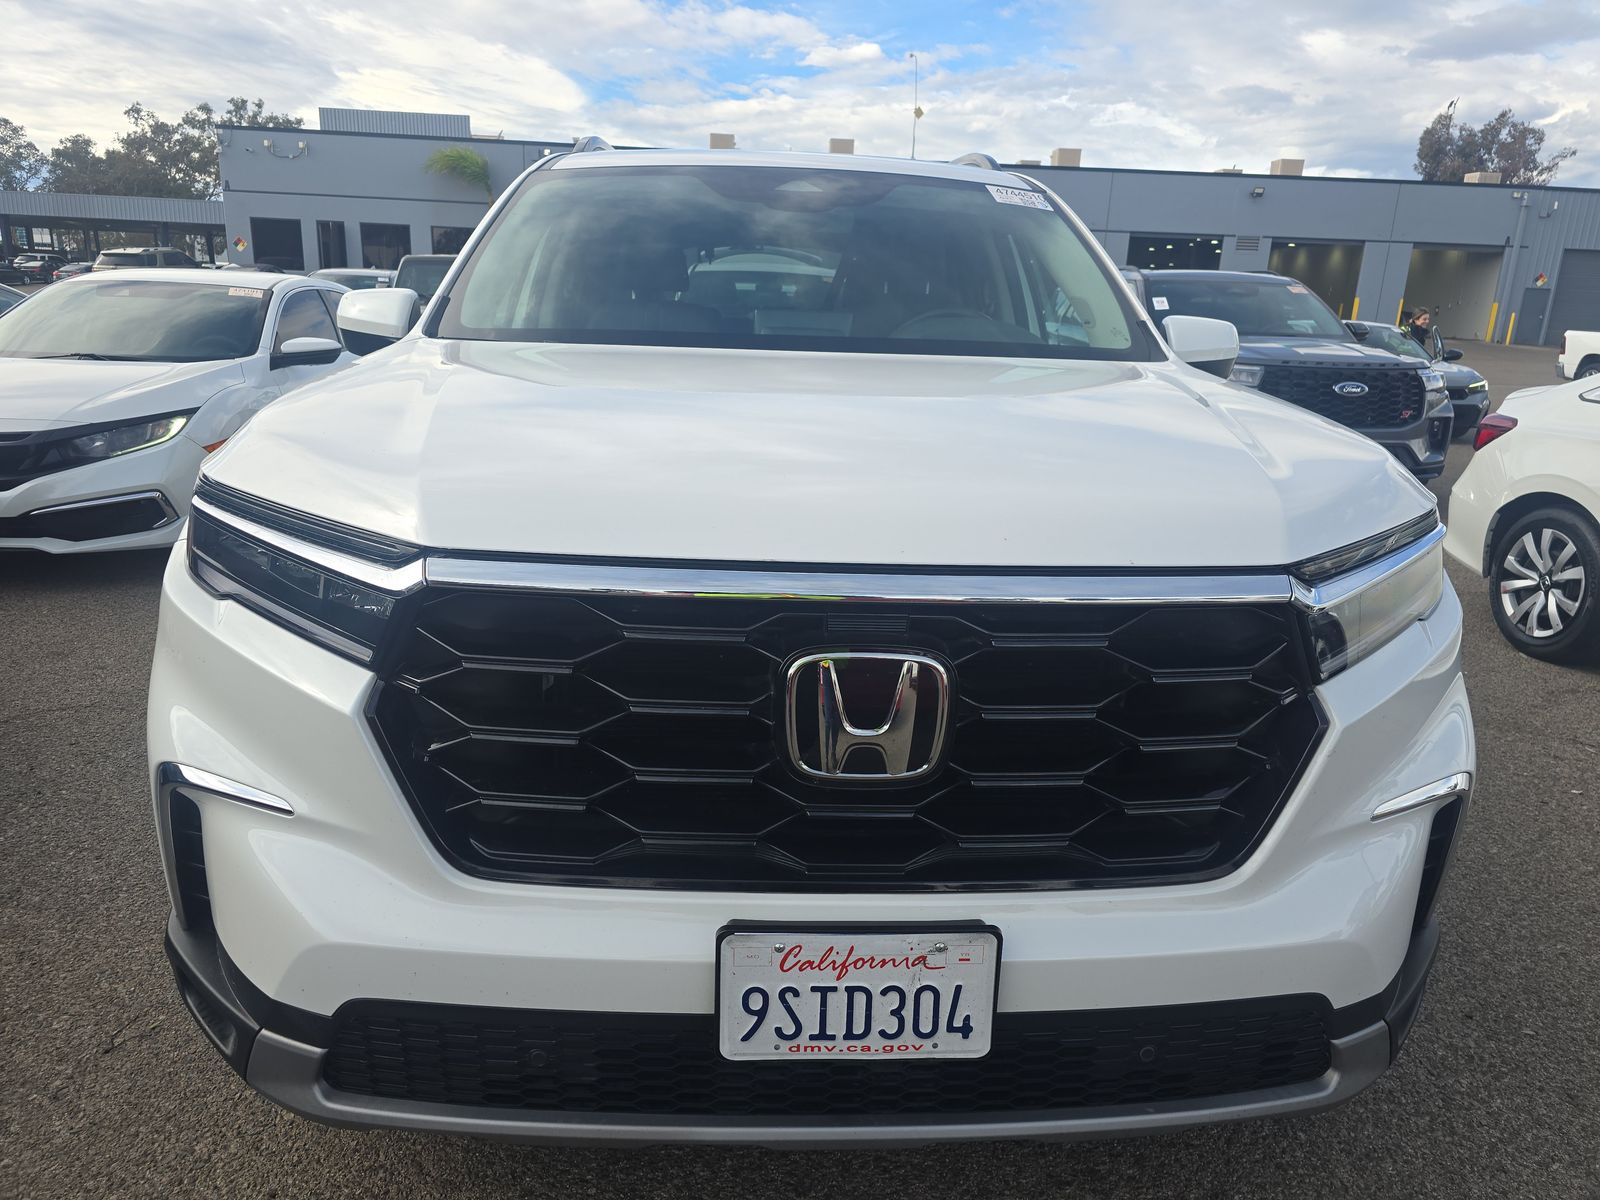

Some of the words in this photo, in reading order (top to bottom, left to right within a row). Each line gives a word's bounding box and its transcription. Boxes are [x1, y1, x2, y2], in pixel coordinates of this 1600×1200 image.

[1343, 385, 1361, 393] Ford
[779, 944, 946, 982] California
[740, 984, 974, 1042] 9SID304
[788, 1043, 925, 1054] dmv.ca.gov
